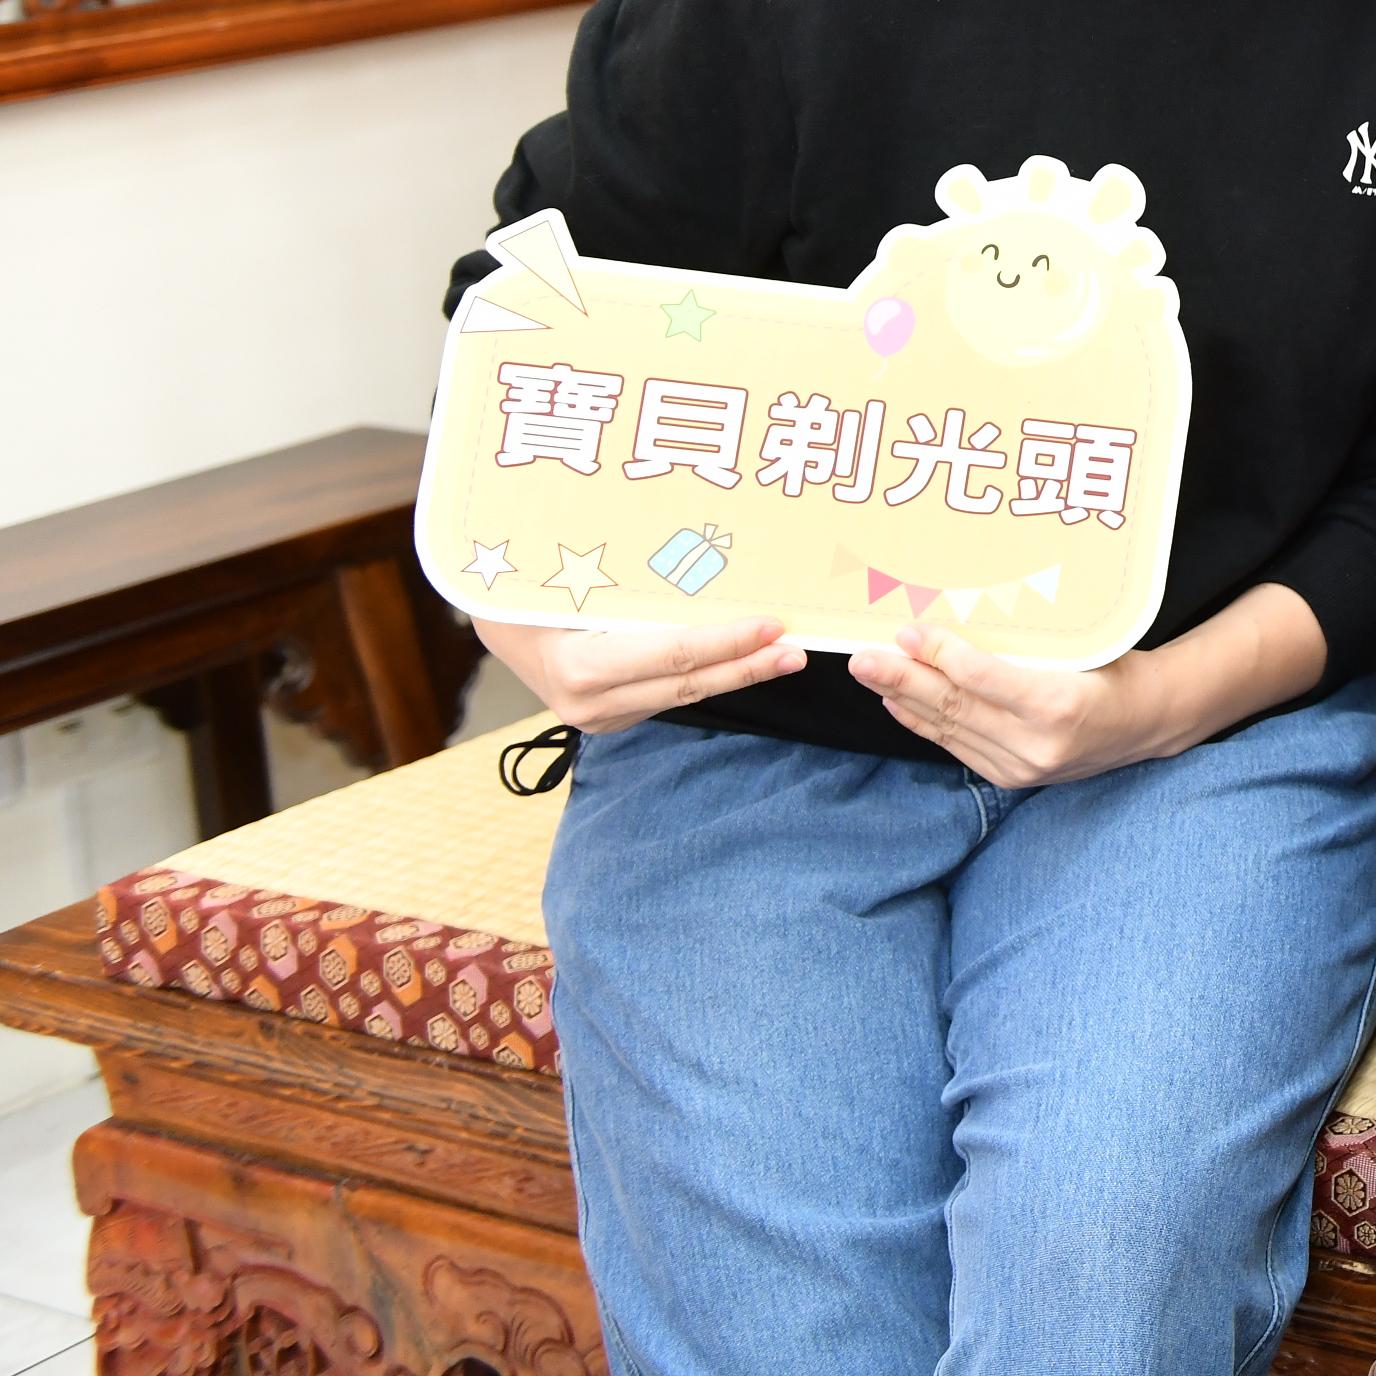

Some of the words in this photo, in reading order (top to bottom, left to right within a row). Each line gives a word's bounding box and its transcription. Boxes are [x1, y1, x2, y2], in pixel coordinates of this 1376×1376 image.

[495, 362, 1138, 531] 寶貝剃光頭
